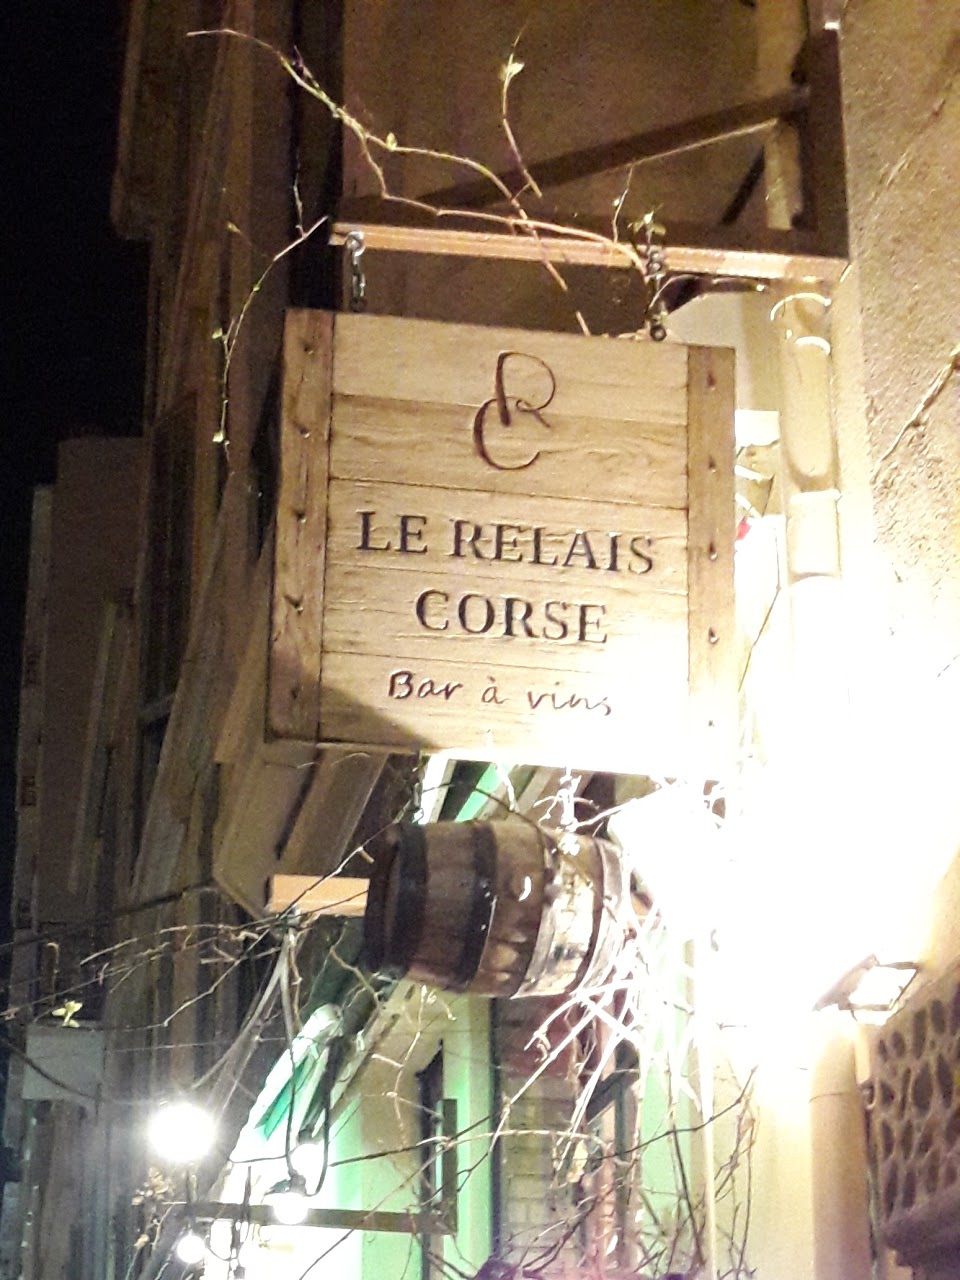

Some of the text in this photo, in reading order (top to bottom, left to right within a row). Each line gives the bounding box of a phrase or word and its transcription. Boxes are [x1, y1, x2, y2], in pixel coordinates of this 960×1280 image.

[356, 511, 655, 575] LE RELAIS
[415, 588, 608, 645] CORSE
[388, 669, 613, 717] Bar à vins
